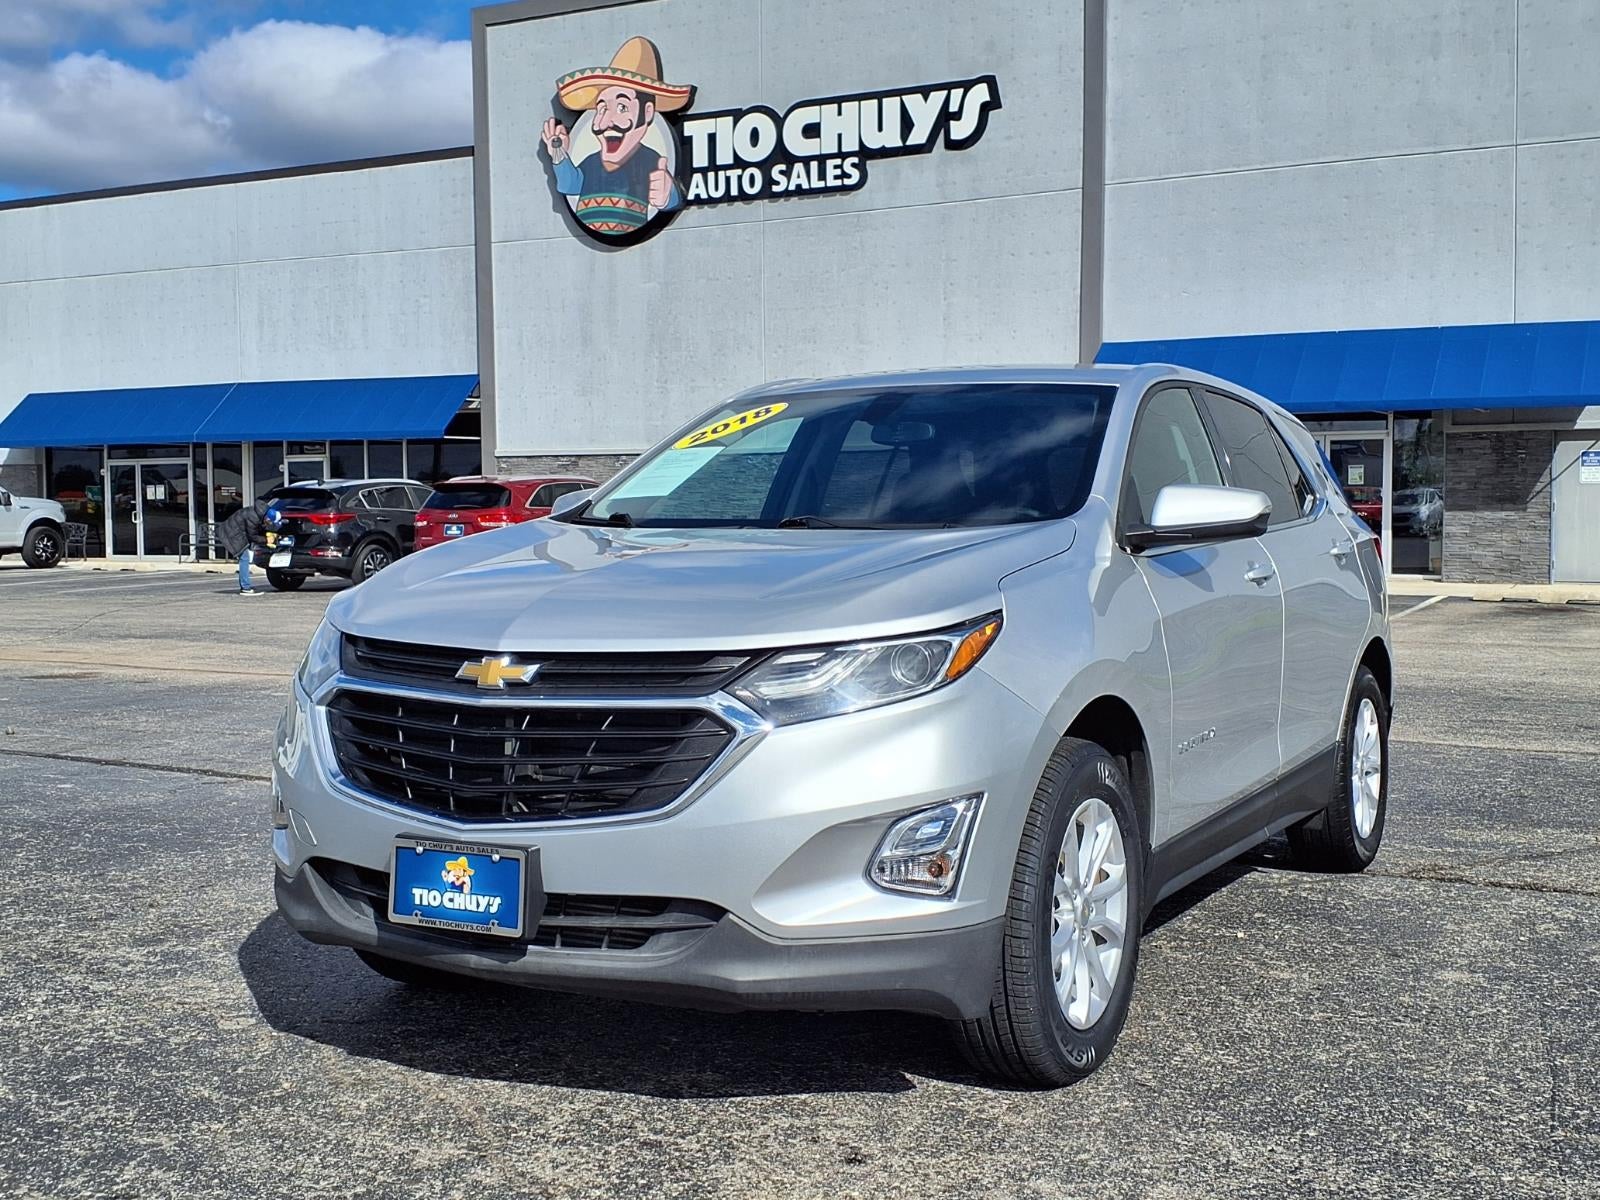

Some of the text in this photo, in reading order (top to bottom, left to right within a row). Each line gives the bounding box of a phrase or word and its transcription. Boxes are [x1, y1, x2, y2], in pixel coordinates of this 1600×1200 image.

[684, 82, 990, 168] TIO CHUY'S
[687, 156, 860, 200] AUTO SALES
[688, 407, 772, 445] 2018
[415, 840, 427, 848] TIO
[455, 845, 475, 853] AUTO
[476, 847, 500, 855] SALES
[412, 888, 502, 913] TIO CHUY'S
[418, 918, 492, 932] WWW.TIOCHUYS.COM
